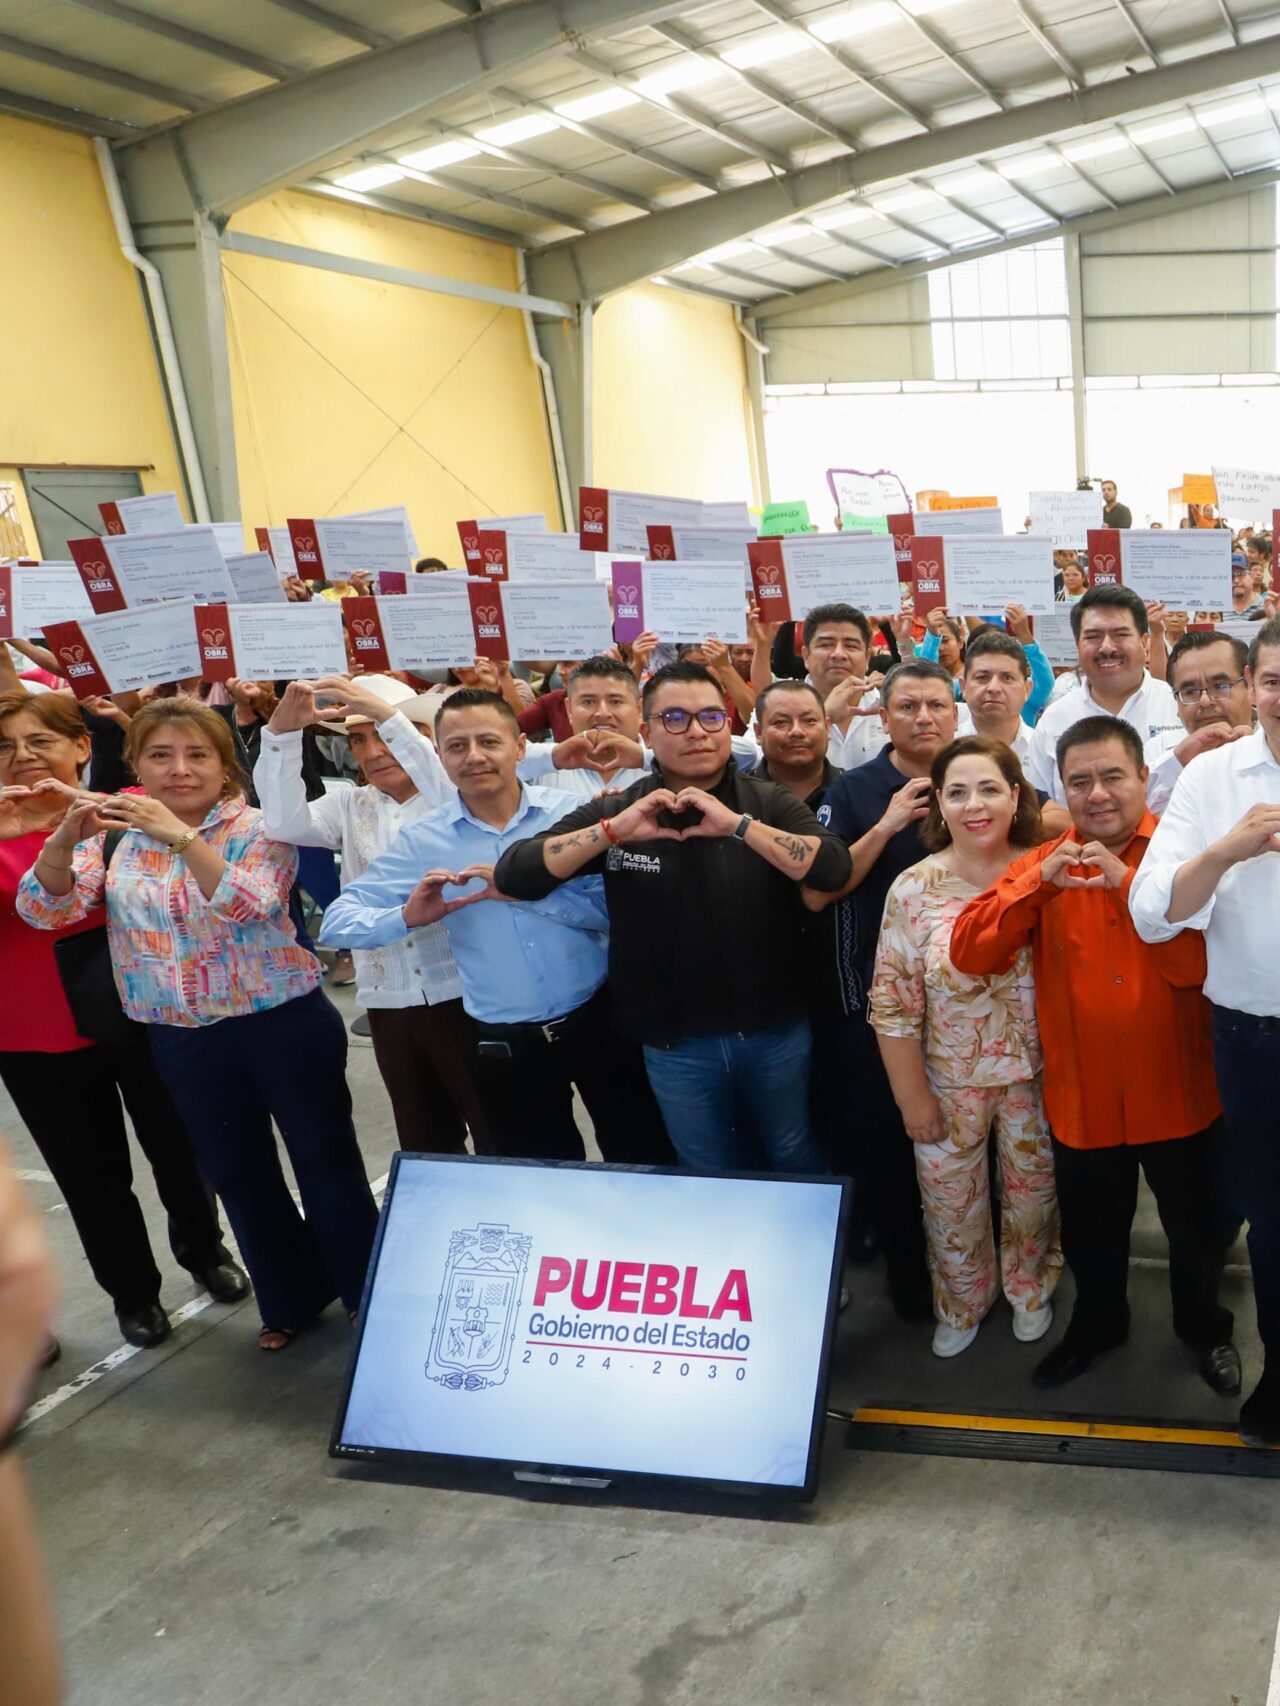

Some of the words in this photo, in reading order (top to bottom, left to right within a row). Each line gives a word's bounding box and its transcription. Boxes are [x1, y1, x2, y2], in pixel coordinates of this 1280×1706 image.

[89, 581, 113, 590] OBRA
[760, 587, 782, 595] OBRA
[479, 627, 500, 635] OBRA
[205, 649, 228, 657] OBRA
[68, 664, 95, 676] OBRA
[623, 852, 661, 865] PUEBLA
[533, 1256, 753, 1322] PUEBLA
[528, 1312, 630, 1342] Gobierno
[632, 1321, 668, 1345] del
[671, 1324, 751, 1352] Estado
